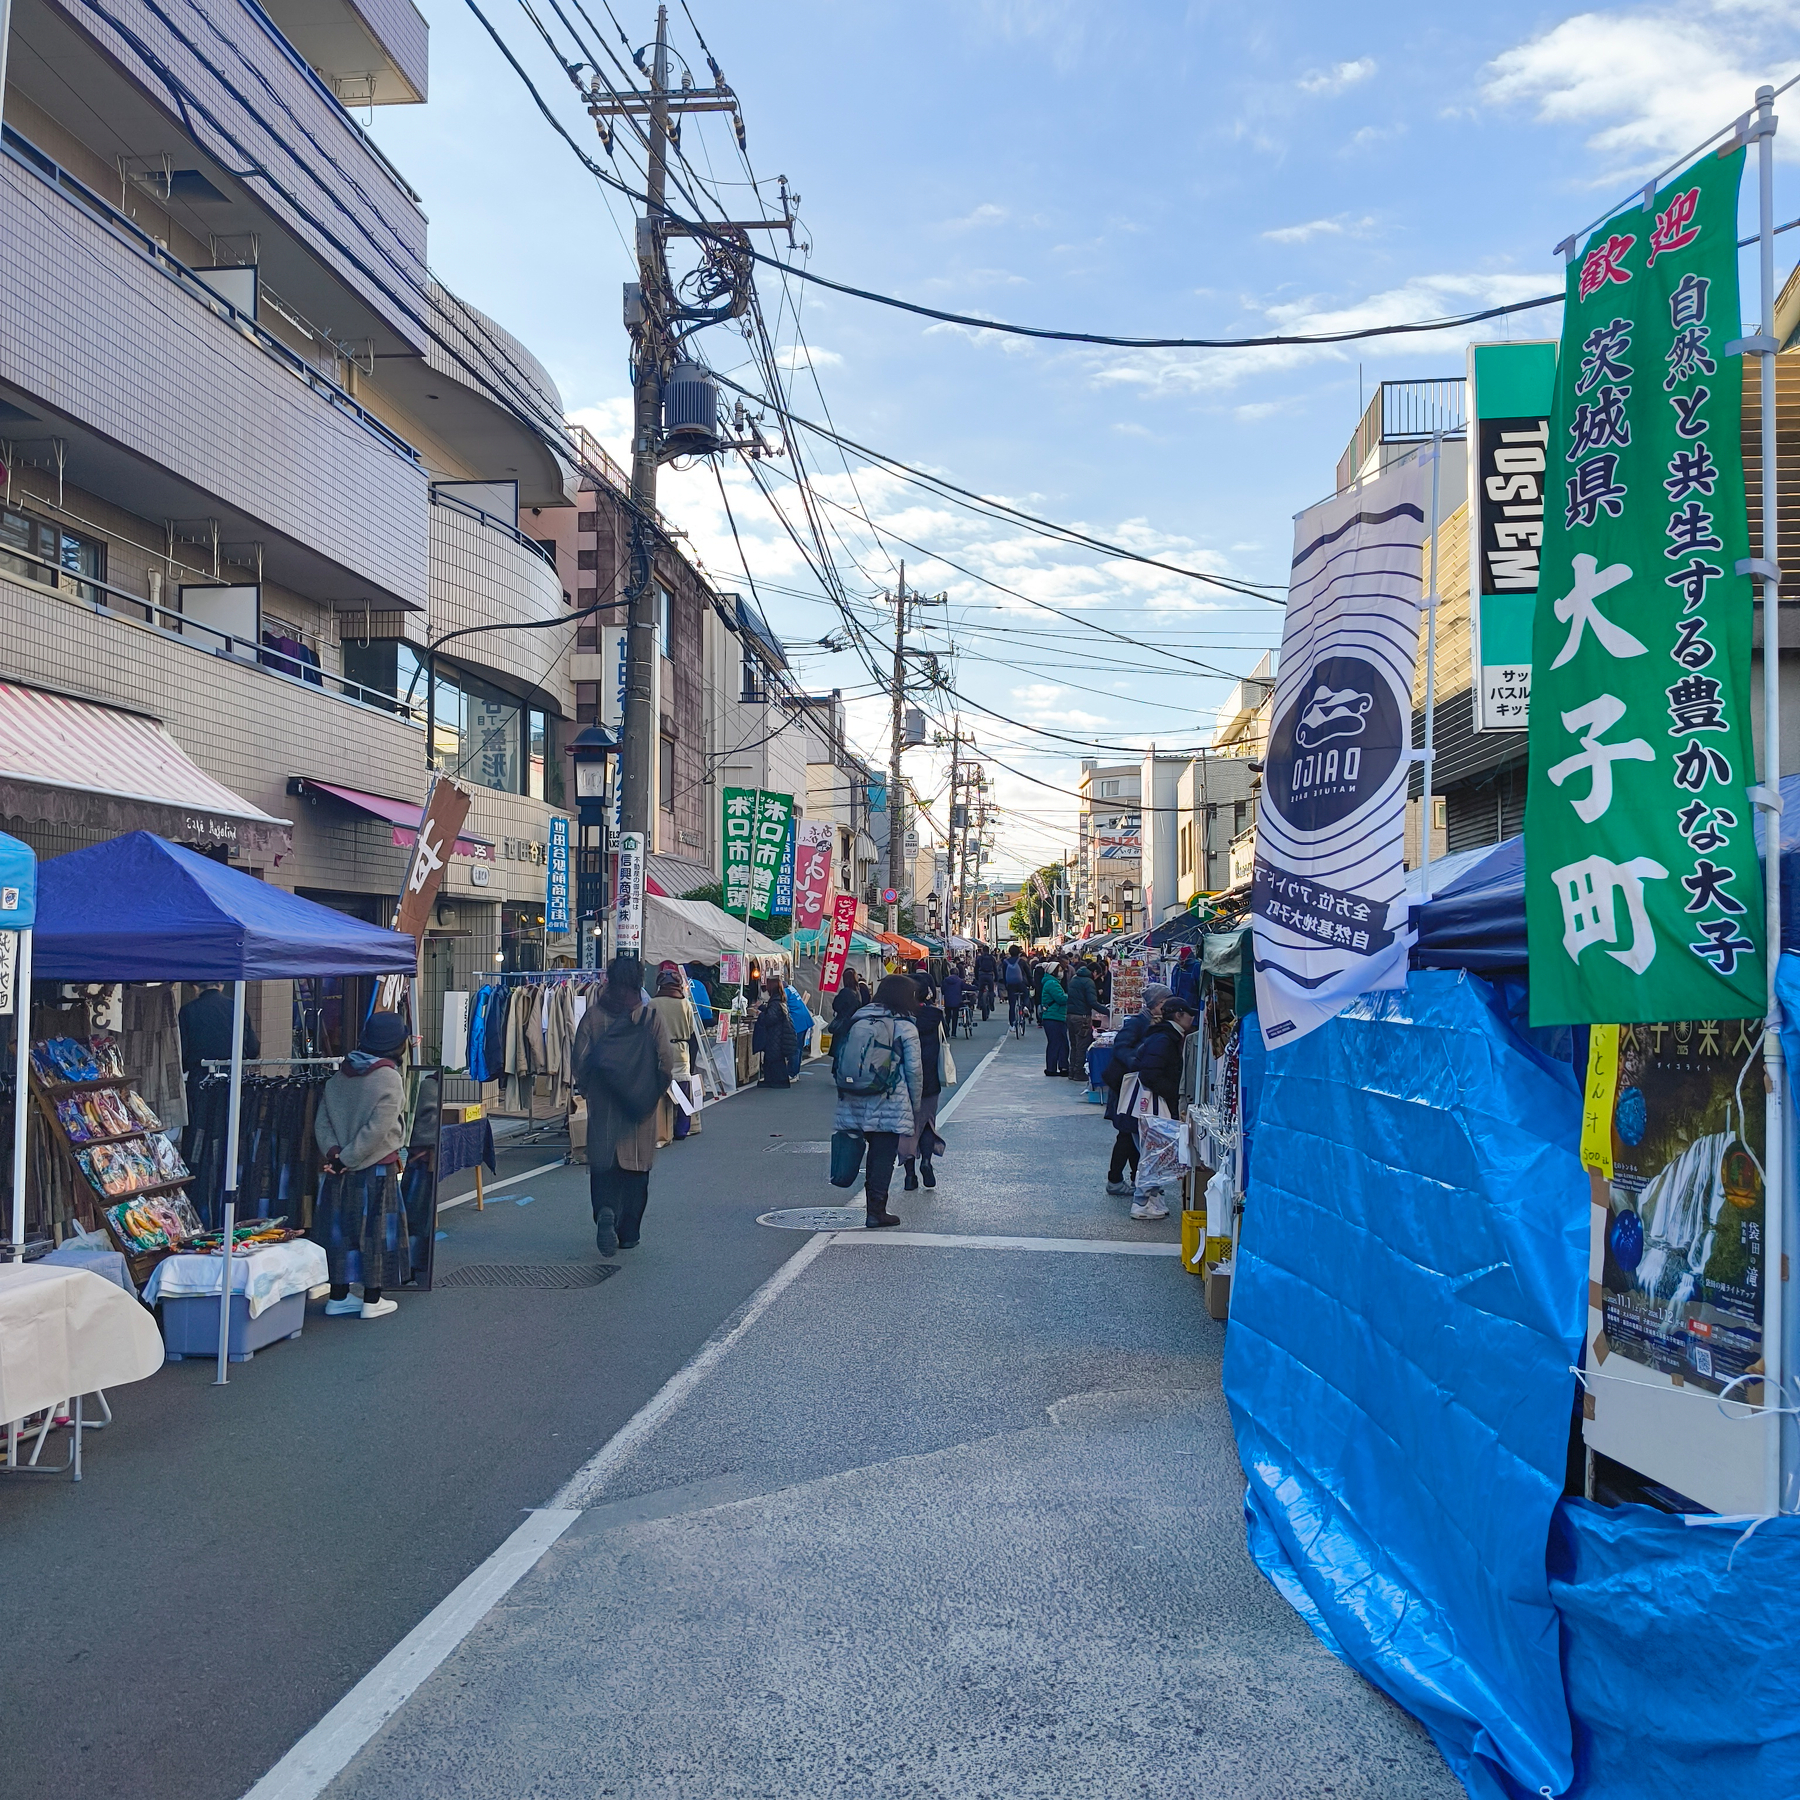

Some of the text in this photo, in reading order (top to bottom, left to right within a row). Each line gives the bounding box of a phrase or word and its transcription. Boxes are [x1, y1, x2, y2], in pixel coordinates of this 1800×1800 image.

[1579, 186, 1701, 303] 歓迎
[1502, 670, 1530, 682] サッ
[1548, 318, 1670, 976] 茨城県 大子町
[1664, 273, 1755, 976] 自然と共生する豊かな大子
[1586, 1025, 1606, 1133] いとん汁
[1584, 1147, 1600, 1161] 500
[1746, 1221, 1760, 1287] 袋田の滝
